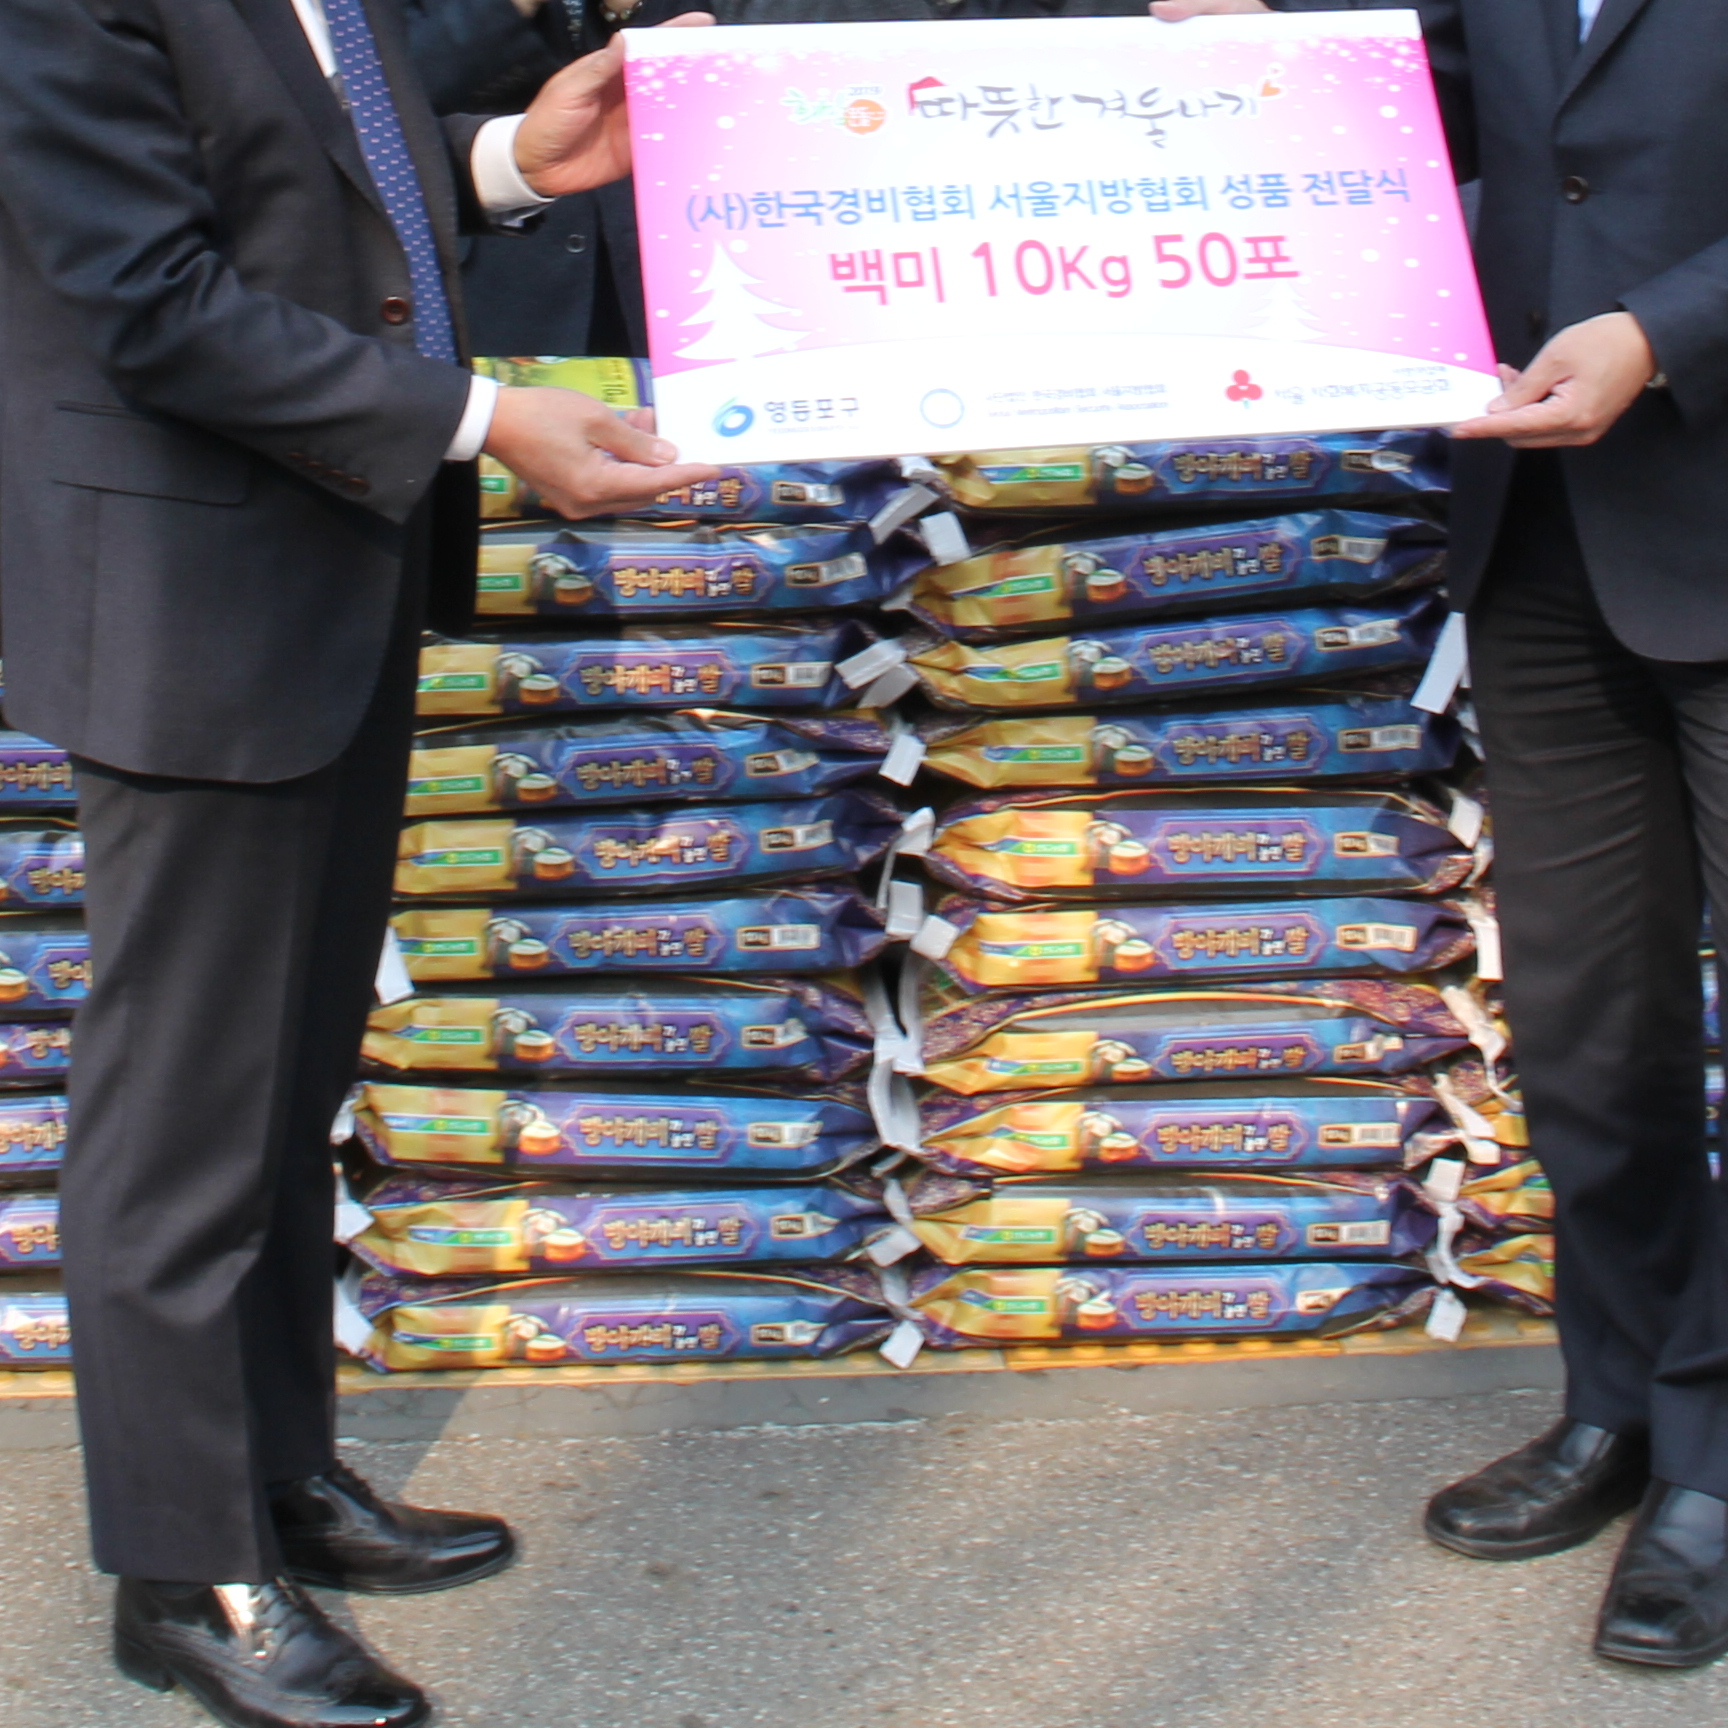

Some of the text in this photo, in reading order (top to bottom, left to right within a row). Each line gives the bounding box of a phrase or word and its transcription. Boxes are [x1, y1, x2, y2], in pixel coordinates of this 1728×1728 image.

[685, 167, 1412, 231] (사)한국경비협회 서울지방협회 성품 전달식
[828, 232, 1300, 308] 백미 10Kg 50포
[763, 397, 860, 423] 영등포구
